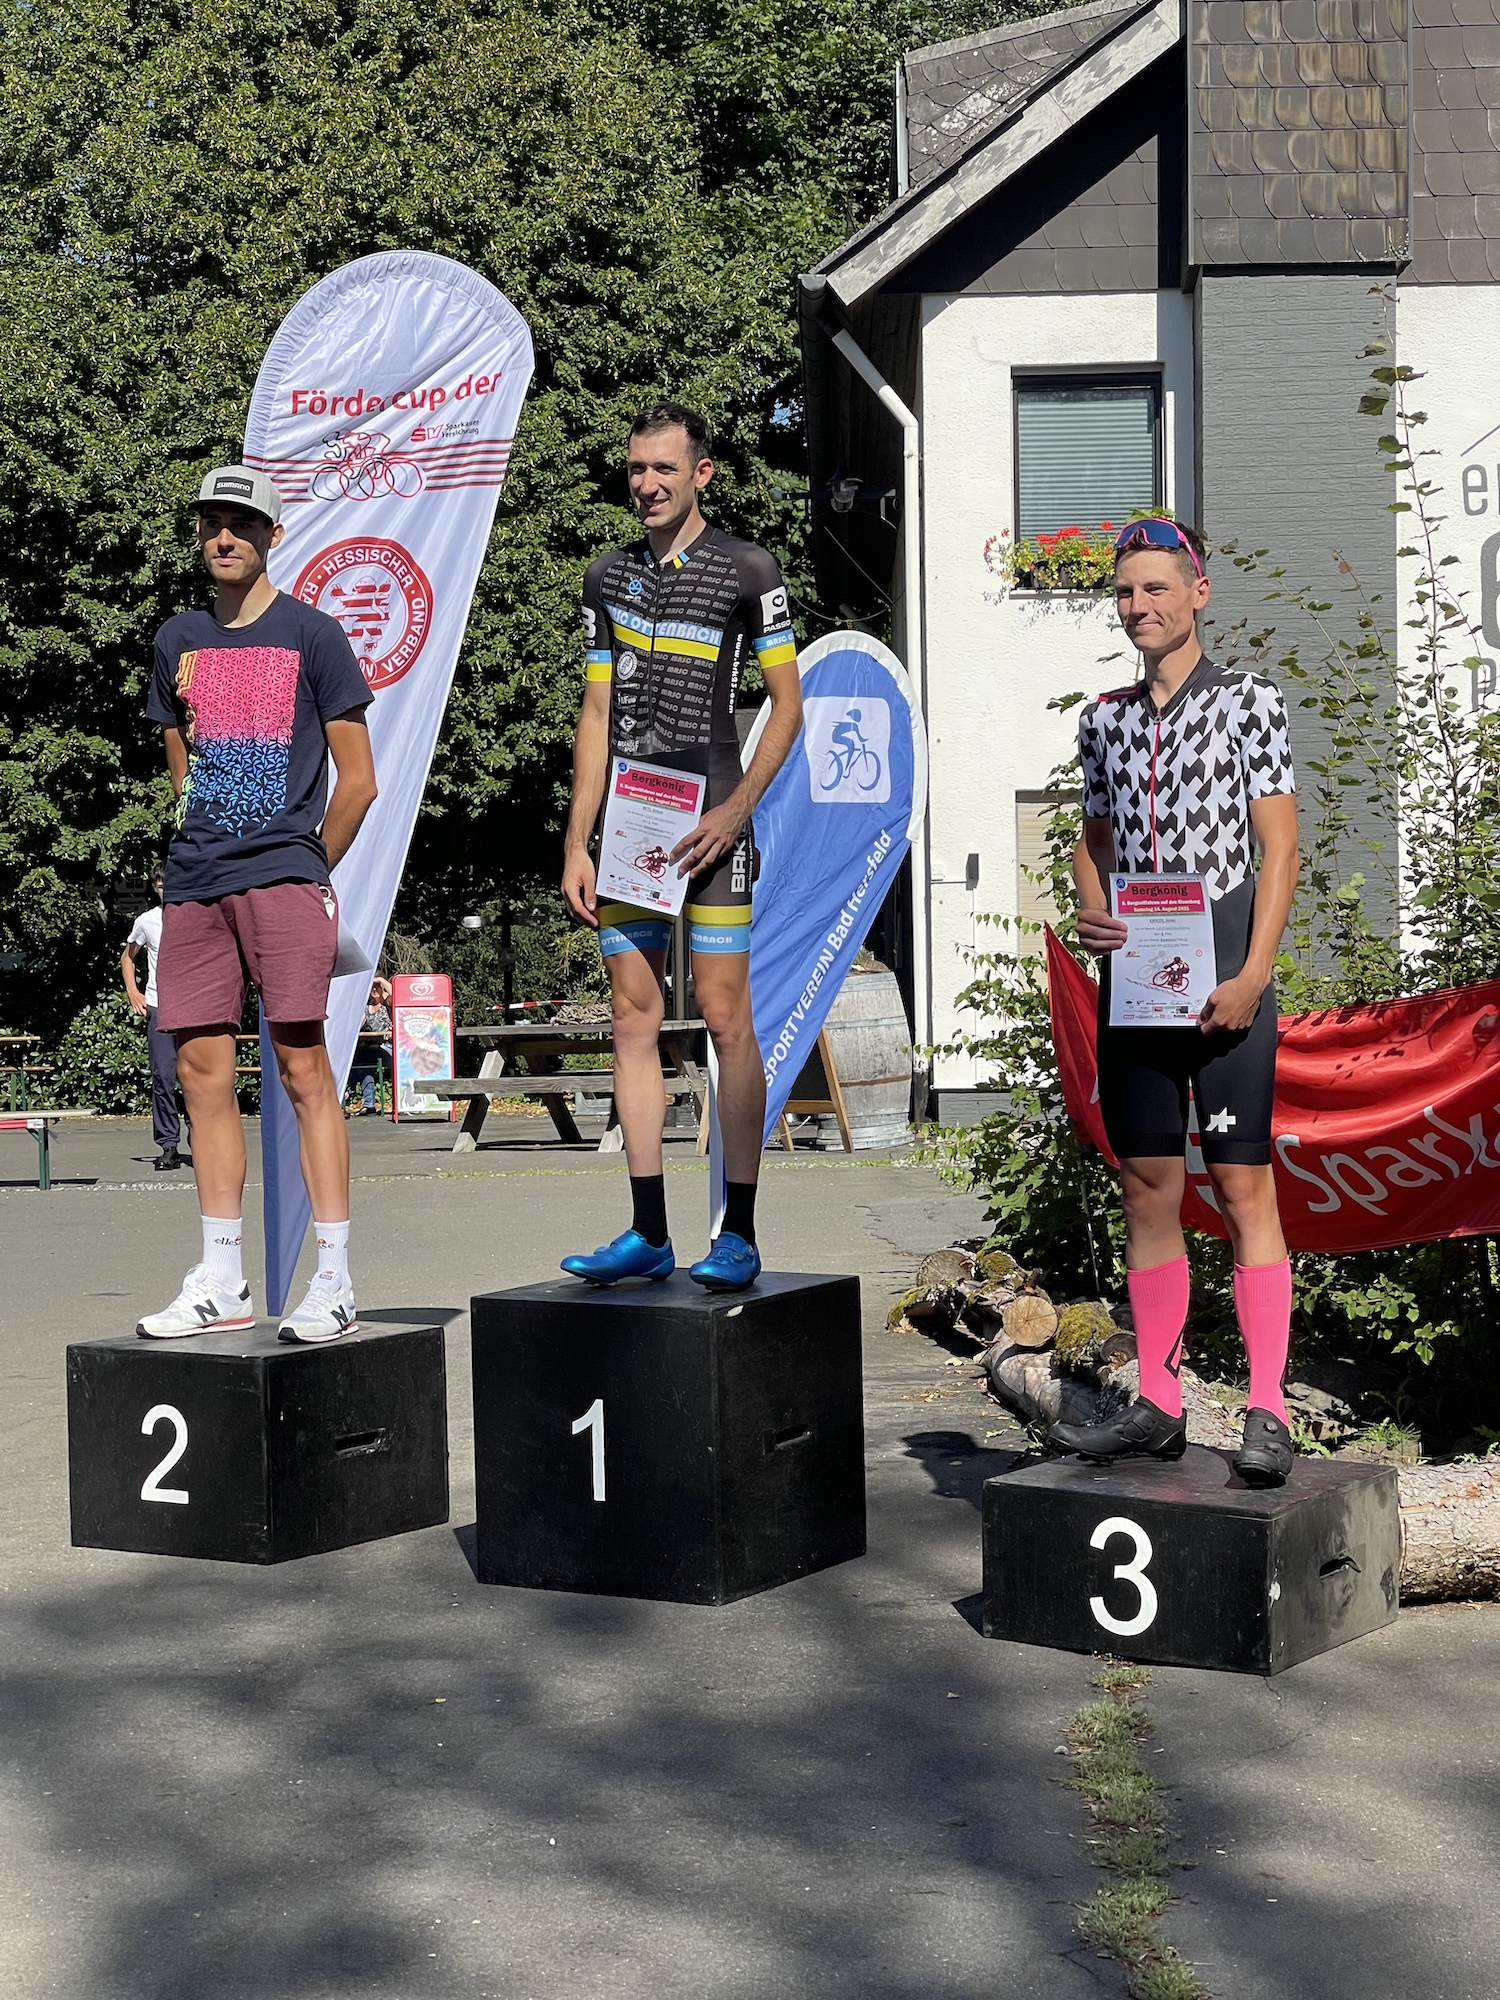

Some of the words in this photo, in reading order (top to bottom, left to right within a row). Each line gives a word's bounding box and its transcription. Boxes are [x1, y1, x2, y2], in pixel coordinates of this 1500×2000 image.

[454, 372, 502, 400] der
[216, 482, 250, 491] SHIMANO
[323, 549, 414, 589] HESSISCHER
[382, 598, 426, 673] VERBAND
[630, 617, 723, 646] OTTENBACH
[729, 633, 744, 714] www.brk23.com
[632, 772, 686, 794] Bergkönig
[1131, 885, 1188, 896] Bergkönig
[600, 930, 653, 947] OTTENBACH
[764, 948, 835, 1089] SPORTVEREIN
[828, 907, 855, 952] Bad
[846, 829, 893, 913] Hersfeld
[1275, 1103, 1500, 1216] Spark
[193, 1299, 220, 1324] N
[140, 1404, 190, 1505] 2
[571, 1398, 606, 1502] 1
[1089, 1516, 1159, 1637] 3
